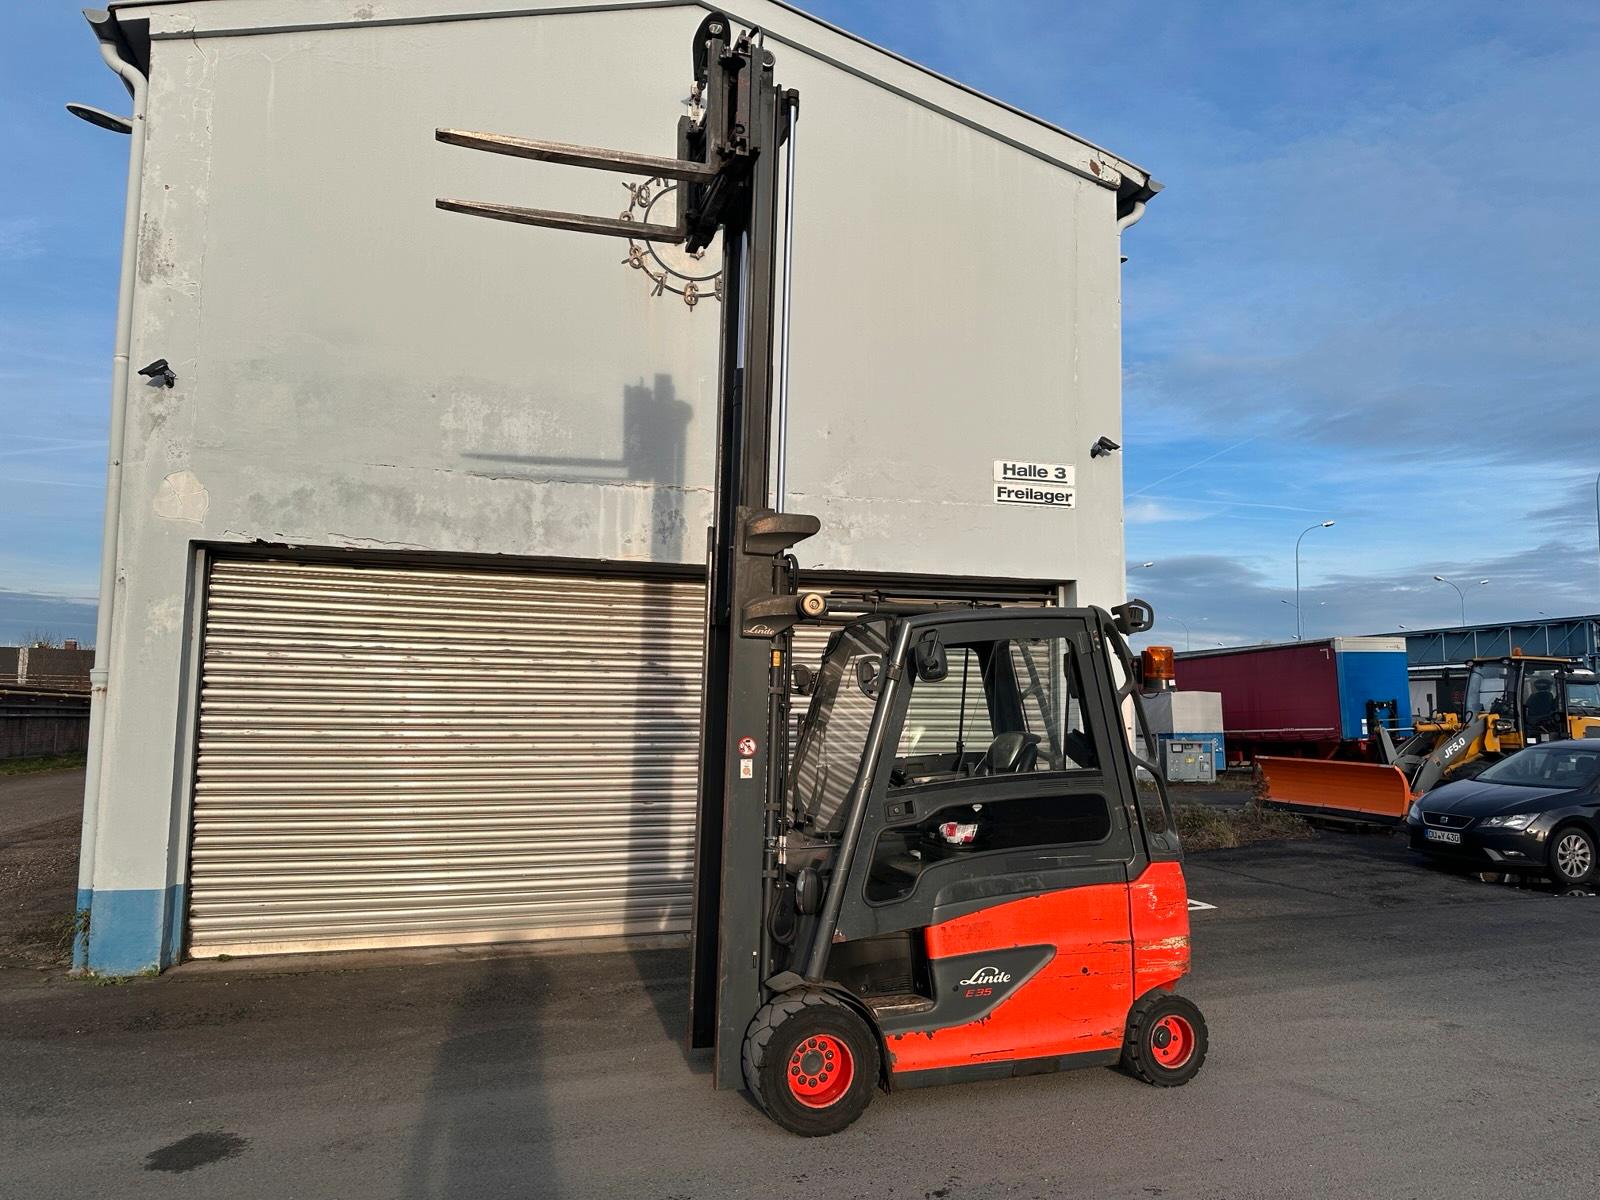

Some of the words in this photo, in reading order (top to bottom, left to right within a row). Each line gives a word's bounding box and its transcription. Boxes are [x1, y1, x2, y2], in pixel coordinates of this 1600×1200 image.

[1003, 463, 1048, 478] Halle
[1054, 467, 1067, 479] 3
[997, 486, 1073, 504] Freilager
[743, 624, 775, 635] Linde
[1444, 737, 1466, 759] JF5.0
[960, 966, 1011, 985] Linde
[965, 989, 975, 998] E
[976, 987, 992, 997] 35
